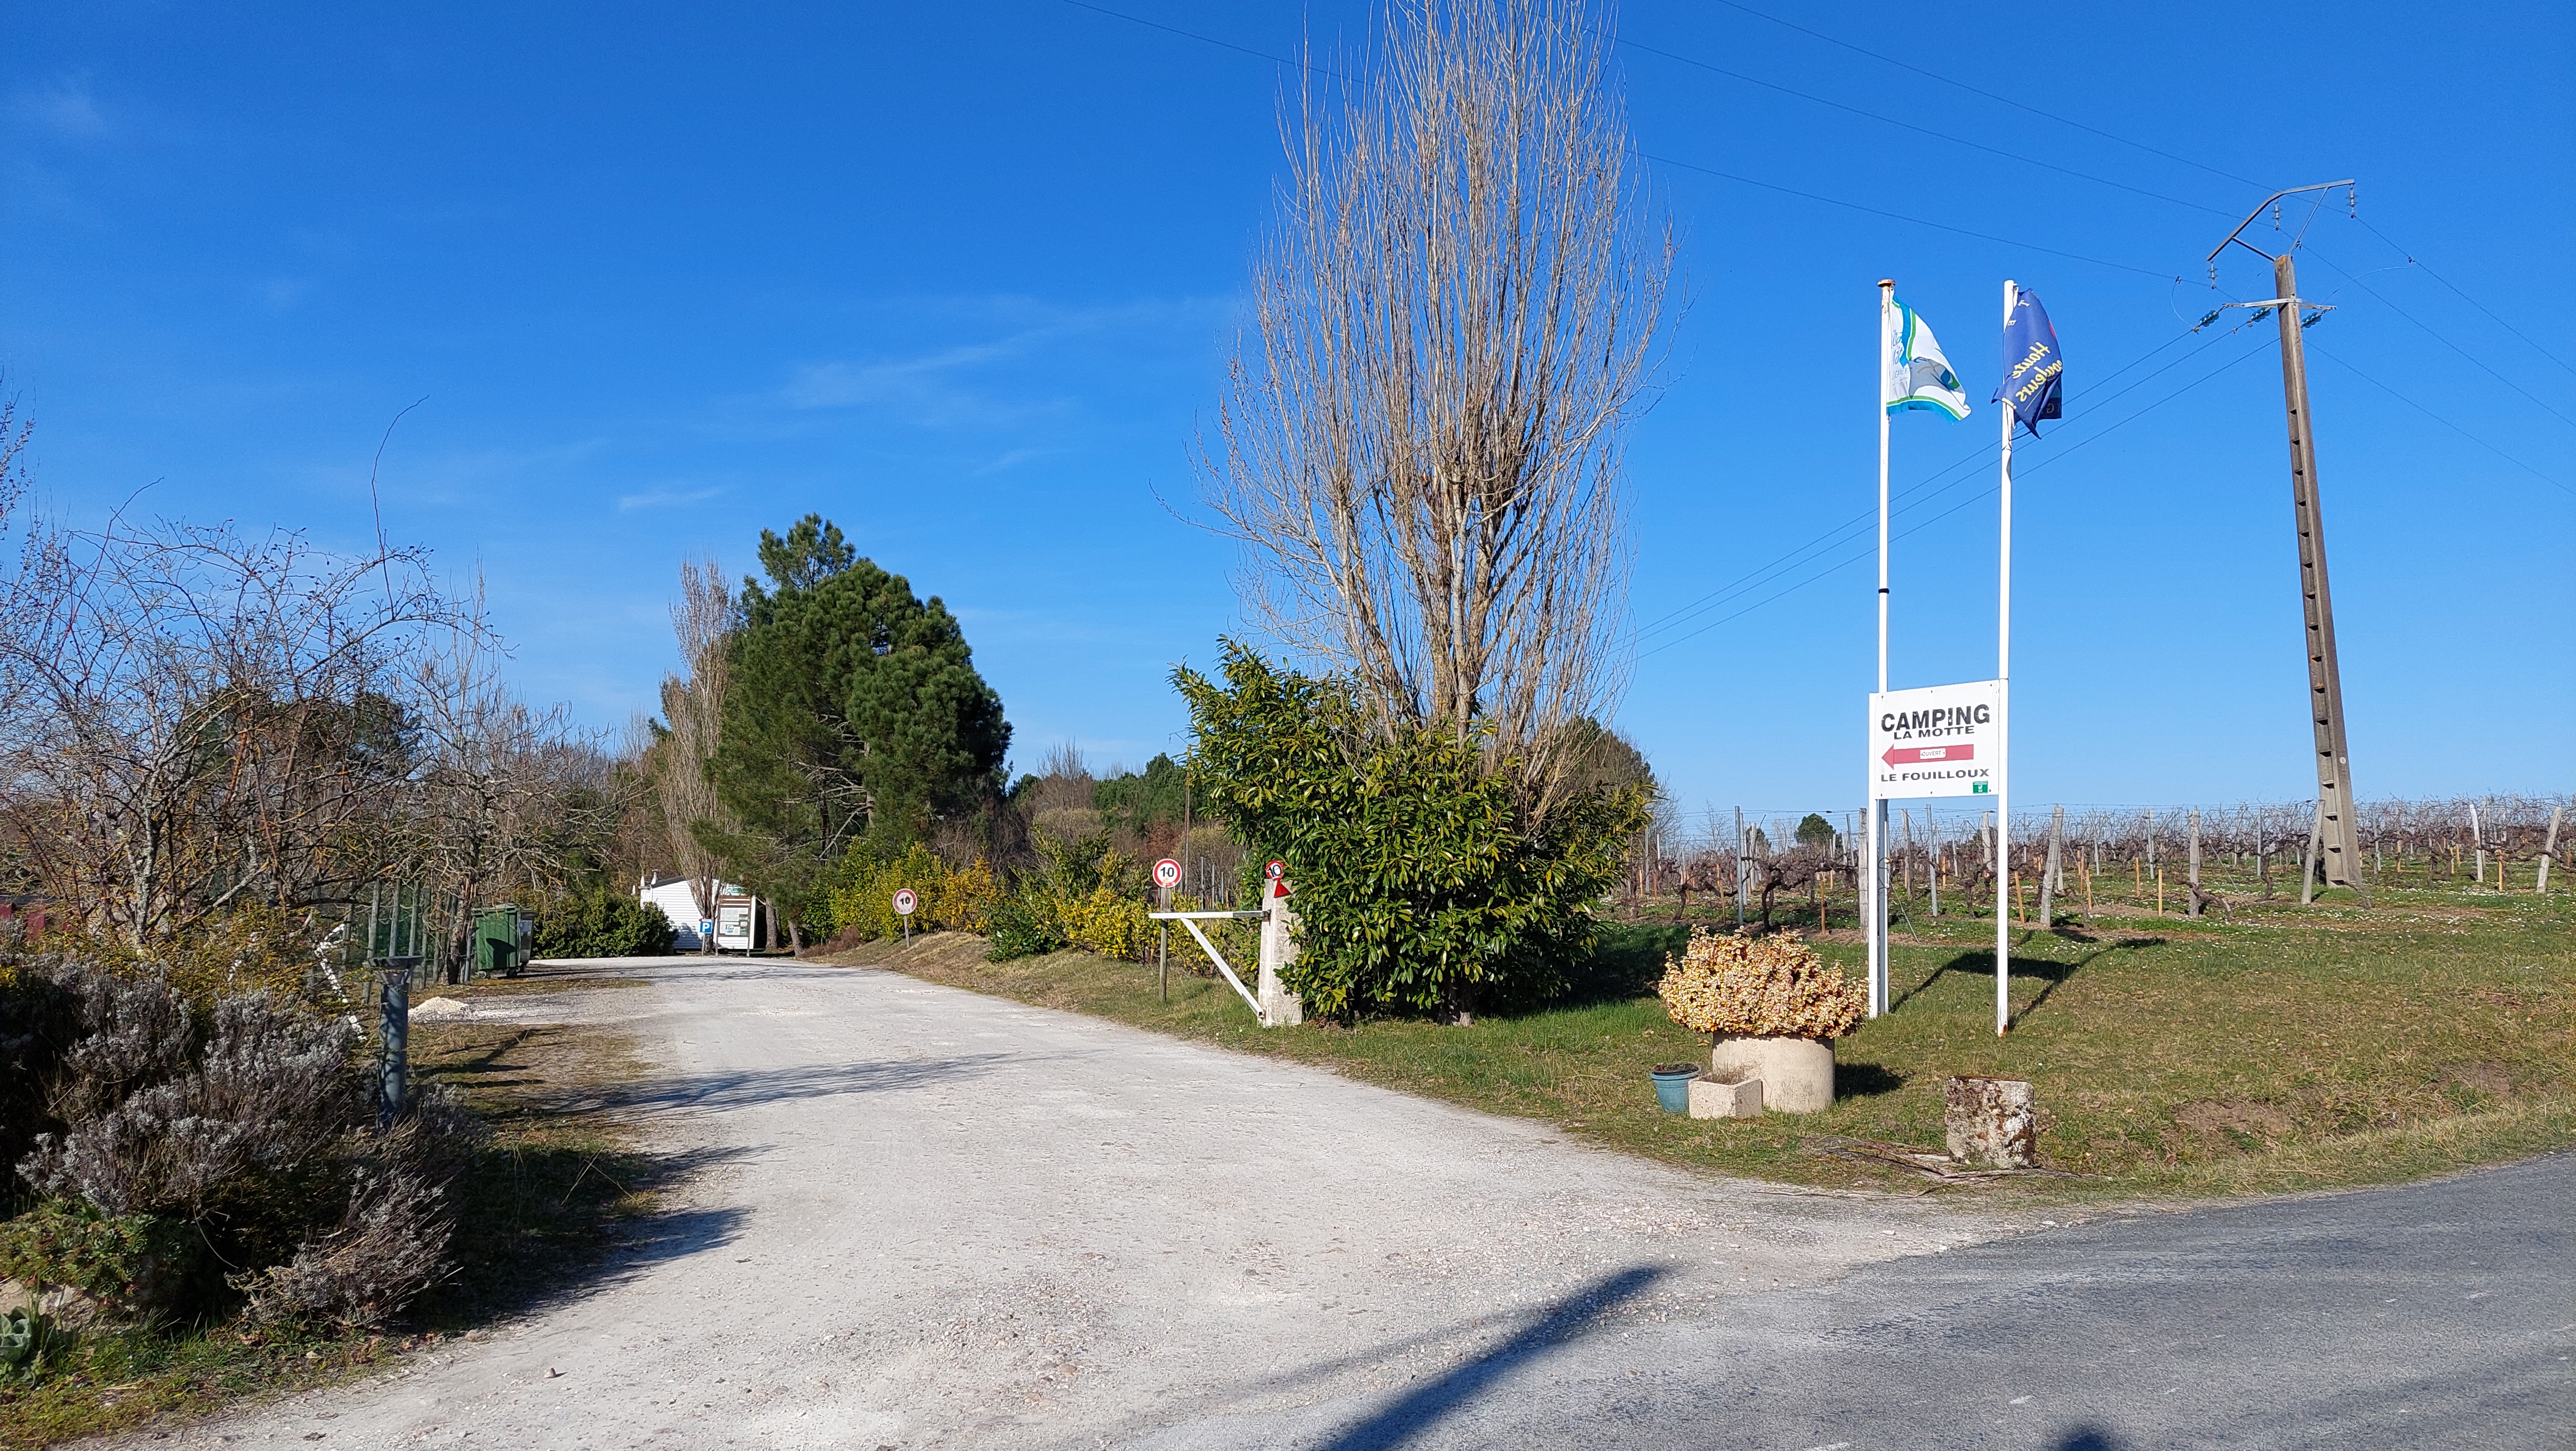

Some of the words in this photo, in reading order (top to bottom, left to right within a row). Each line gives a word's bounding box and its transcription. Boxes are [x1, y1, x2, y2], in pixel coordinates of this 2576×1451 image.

[1881, 704, 1990, 732] CAMPING
[1894, 731, 1913, 739] LA
[1919, 726, 1974, 738] MOTTE
[1902, 768, 1989, 781] FOUILLOUX
[1160, 866, 1174, 877] 10
[1267, 864, 1282, 877] 10
[900, 896, 910, 905] 10
[702, 923, 710, 932] P
